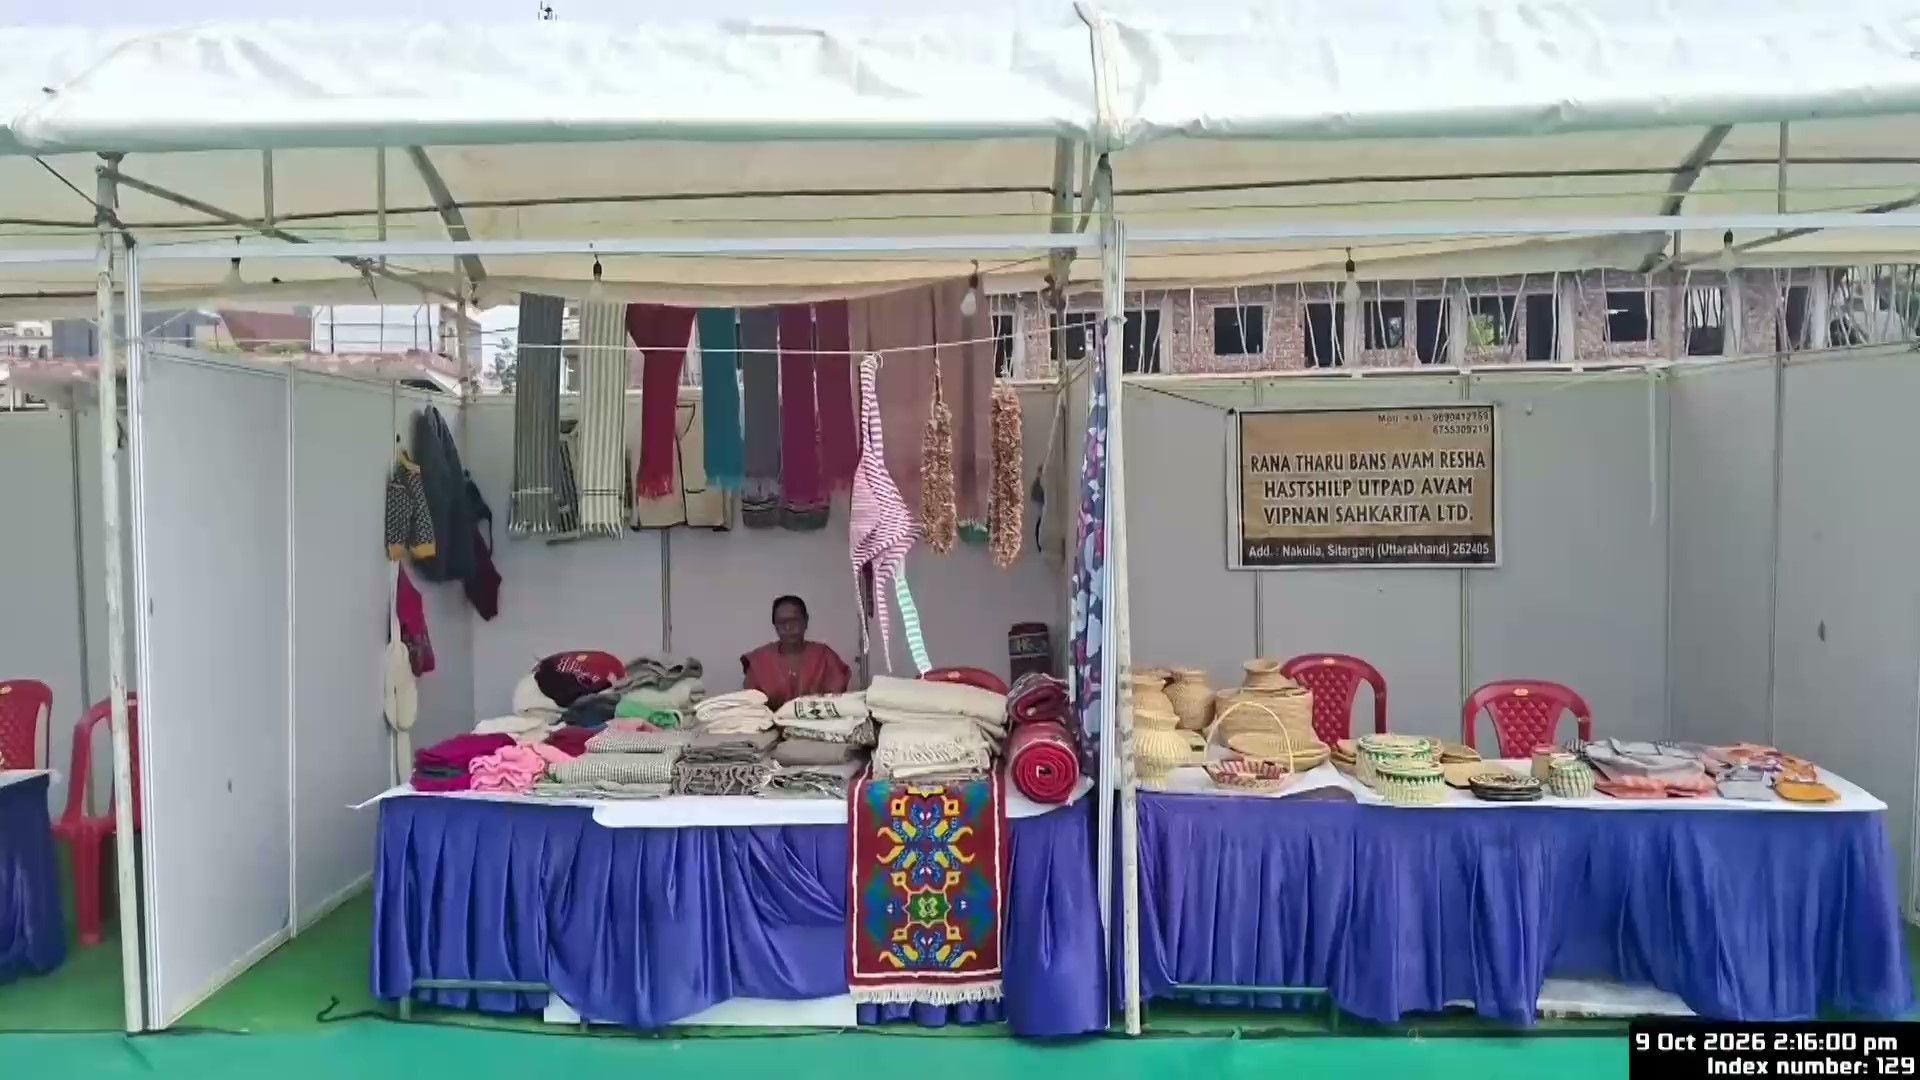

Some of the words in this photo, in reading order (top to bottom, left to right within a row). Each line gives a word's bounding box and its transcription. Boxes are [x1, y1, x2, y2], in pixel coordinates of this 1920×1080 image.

[1250, 453, 1291, 472] RANA
[1296, 453, 1344, 471] THARU
[1350, 452, 1386, 470] BANS
[1391, 451, 1434, 470] AVAM
[1440, 450, 1486, 469] RESHA
[1264, 479, 1352, 498] HASTSHILP
[1358, 478, 1415, 497] UTPAD
[1421, 477, 1473, 495] AVAM
[1264, 506, 1329, 524] VIPNAN
[1336, 504, 1431, 523] SAHKARITA
[1437, 504, 1473, 521] LTD.
[1327, 544, 1375, 559] Sitarganj
[1378, 543, 1450, 559] (Uttarakhand)
[1453, 543, 1489, 554] 262405
